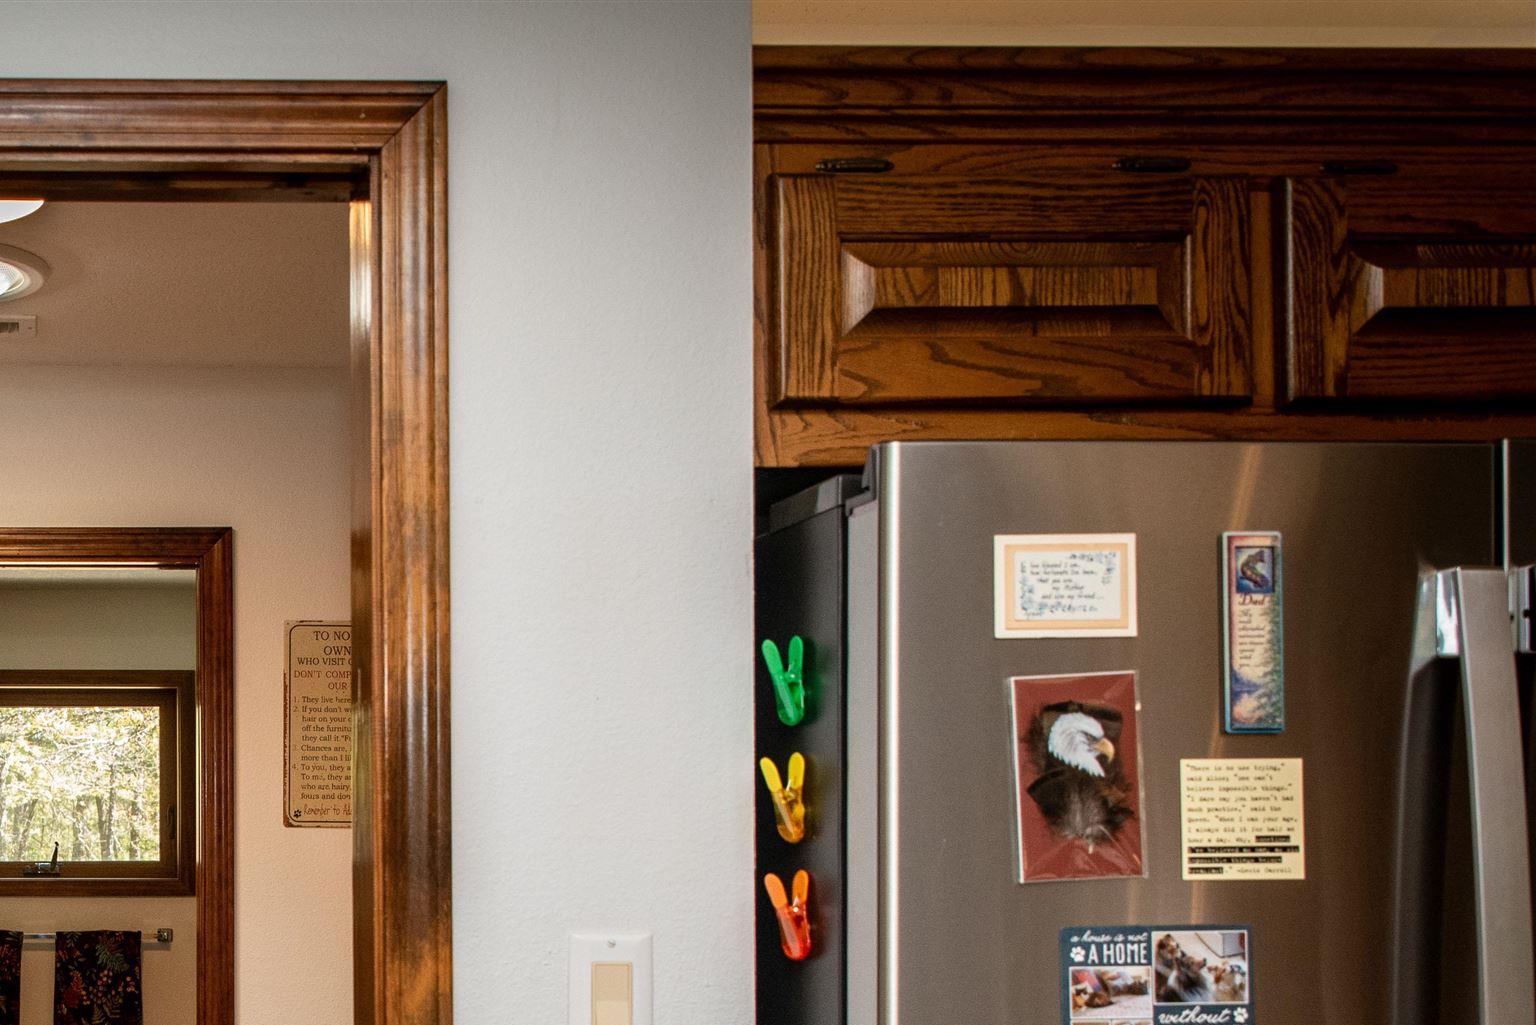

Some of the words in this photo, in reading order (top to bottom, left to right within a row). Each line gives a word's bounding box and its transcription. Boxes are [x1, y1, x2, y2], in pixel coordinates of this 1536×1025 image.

[313, 630, 330, 641] TO
[297, 657, 320, 666] WHO
[322, 657, 346, 666] VISIT
[293, 670, 322, 679] DON'T
[327, 682, 348, 690] OUR
[302, 696, 319, 704] They
[308, 707, 322, 715] you
[302, 734, 318, 743] they
[300, 744, 332, 752] Chances
[329, 764, 345, 773] they
[301, 773, 311, 781] To
[327, 773, 343, 782] they
[321, 792, 336, 800] and
[1081, 929, 1113, 943] house
[1127, 931, 1149, 942] not
[1087, 943, 1100, 965] A
[1102, 942, 1148, 965] HOME
[1158, 1005, 1232, 1024] without
